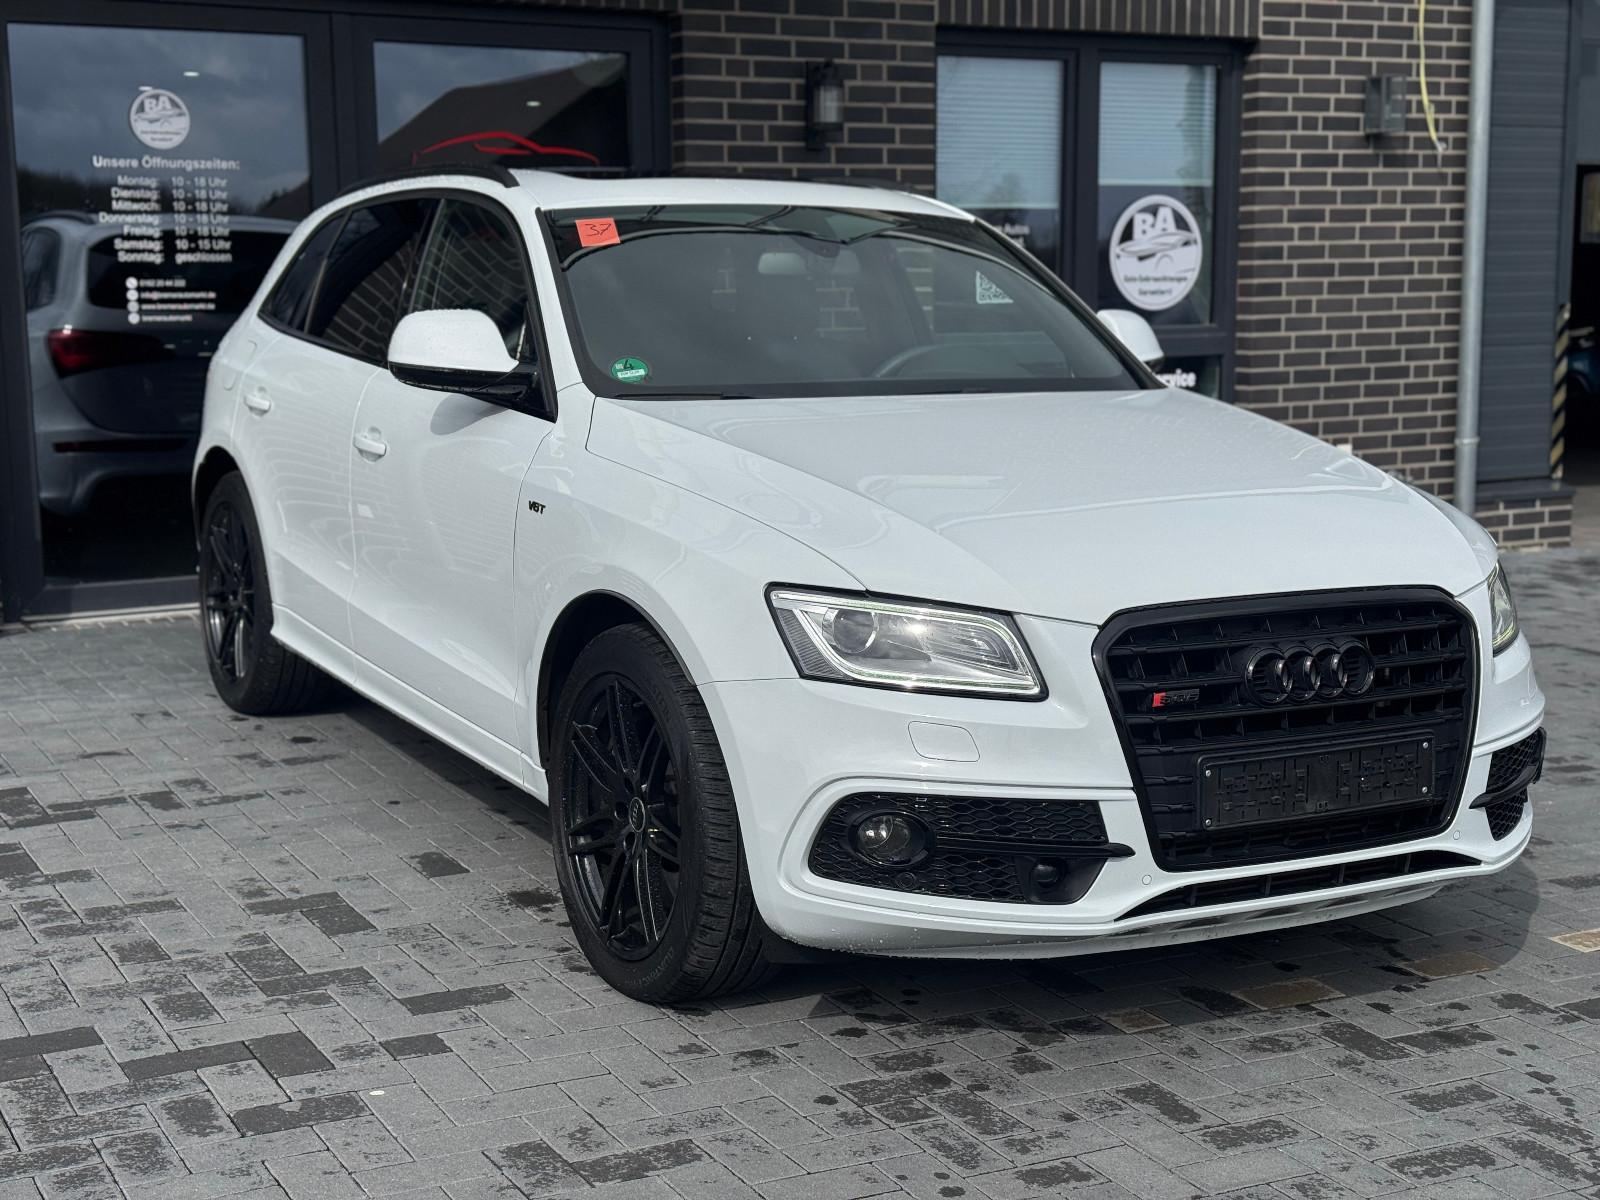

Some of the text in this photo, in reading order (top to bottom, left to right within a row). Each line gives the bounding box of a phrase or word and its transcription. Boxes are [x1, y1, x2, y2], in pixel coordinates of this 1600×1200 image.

[92, 153, 240, 172] Unsere Öffnungszeiten:
[171, 177, 184, 187] 10
[208, 177, 227, 187] Uhr
[172, 189, 184, 199] 10
[208, 189, 228, 199] Uhr
[172, 201, 185, 211] 10
[209, 201, 228, 211] Uhr
[174, 214, 186, 223] 10
[210, 214, 229, 224] Uhr
[1133, 206, 1177, 241] BA
[175, 226, 187, 236] 10
[211, 226, 230, 236] Uhr
[175, 239, 188, 249] 10
[212, 239, 232, 249] Uhr
